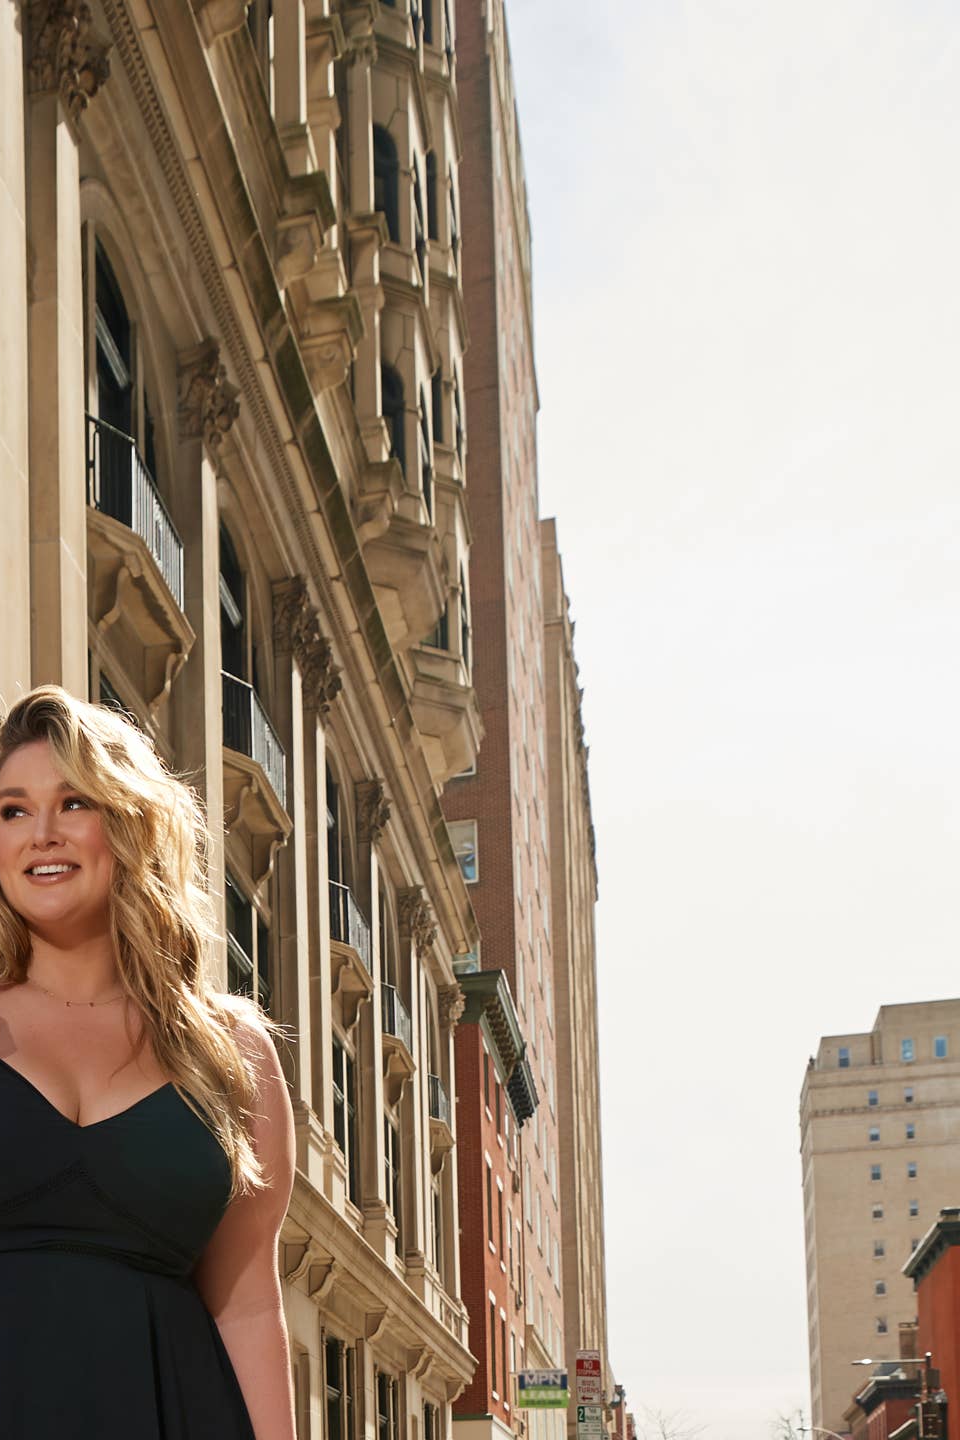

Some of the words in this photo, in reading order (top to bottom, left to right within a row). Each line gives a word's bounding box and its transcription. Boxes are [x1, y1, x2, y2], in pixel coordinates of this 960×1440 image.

[583, 1360, 592, 1369] NO
[524, 1373, 561, 1385] MPN
[578, 1408, 584, 1421] 2
